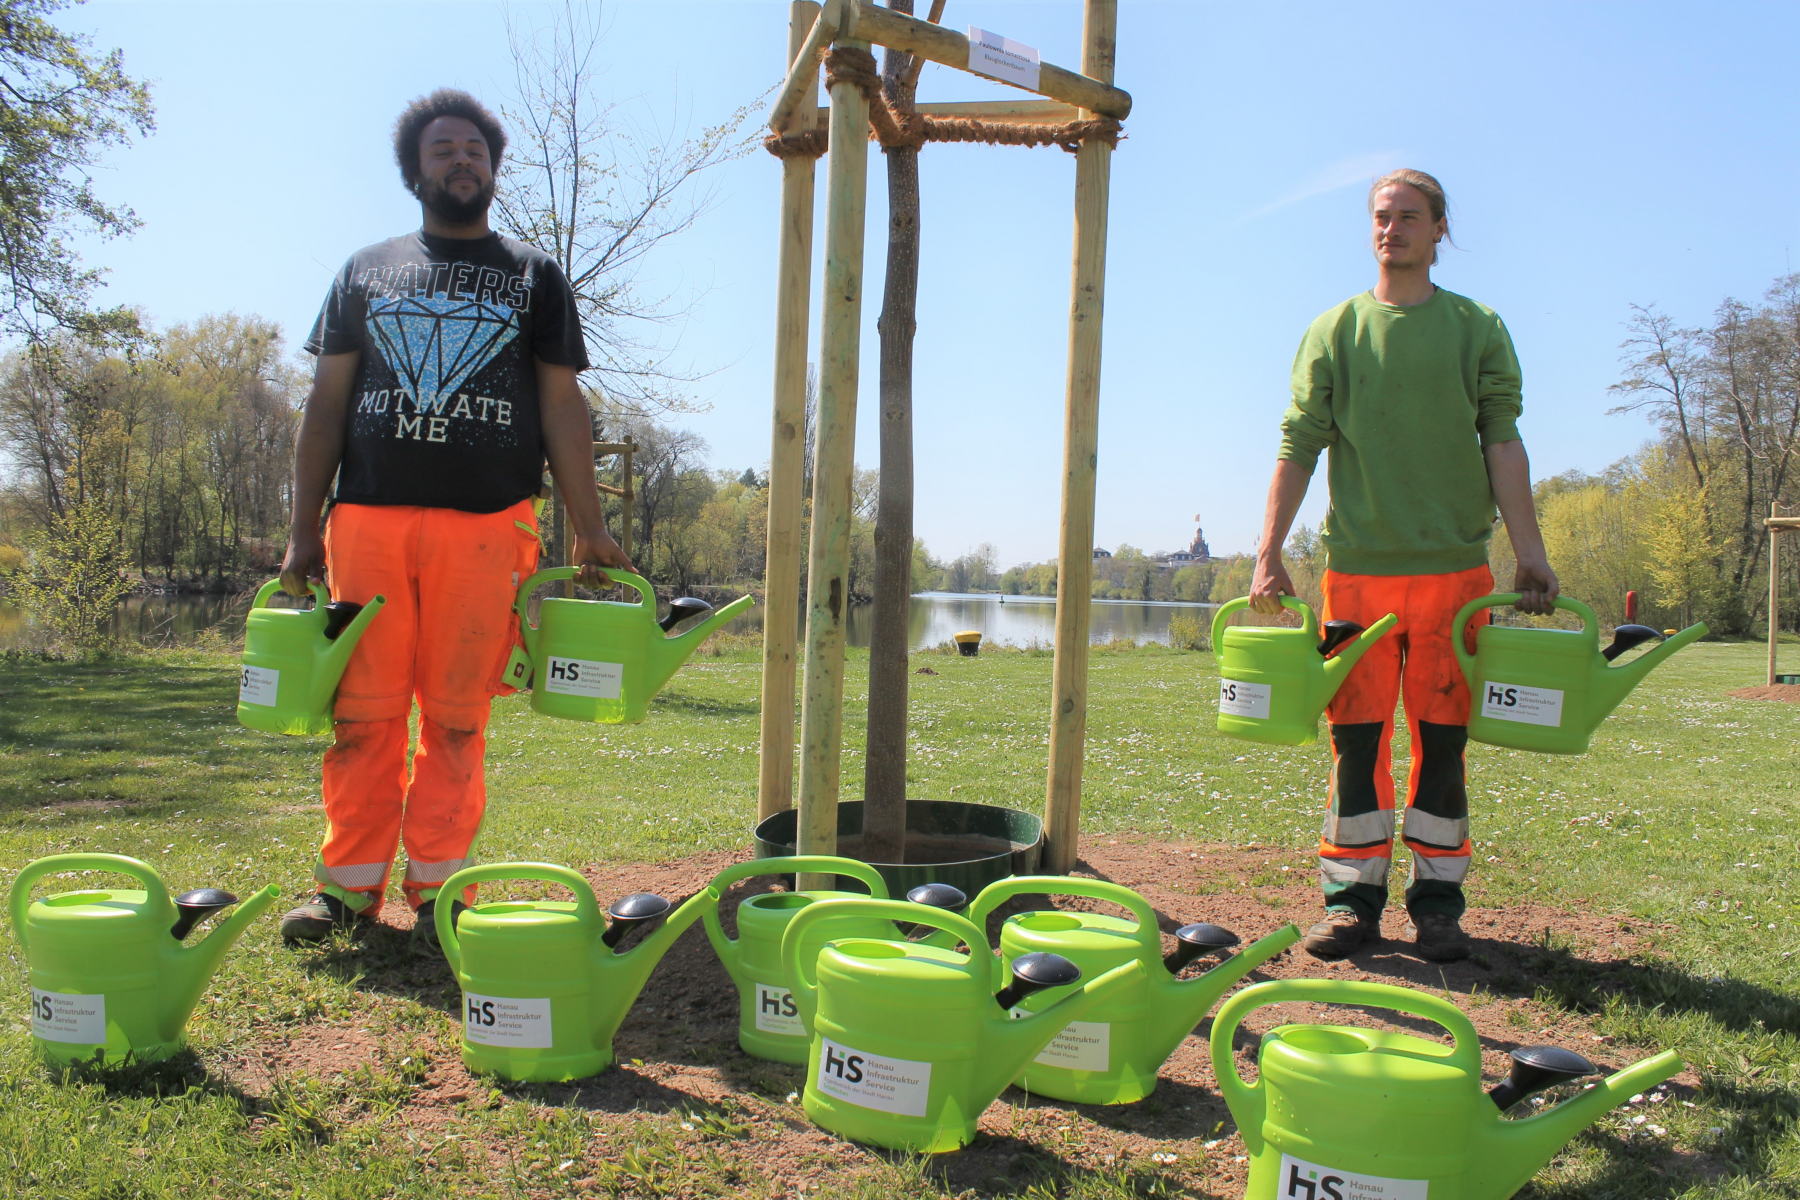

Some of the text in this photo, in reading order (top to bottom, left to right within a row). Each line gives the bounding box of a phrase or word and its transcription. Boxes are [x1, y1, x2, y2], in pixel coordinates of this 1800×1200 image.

[361, 262, 533, 312] HATERS
[357, 388, 512, 426] MOTIVATE
[395, 414, 449, 443] ME
[581, 670, 616, 678] Infrastruktur
[1519, 697, 1556, 706] Infrastruktur
[54, 998, 74, 1006] Hanau
[497, 1003, 519, 1011] Hanau
[54, 1007, 96, 1016] Infrastruktur
[497, 1012, 542, 1020] Infrastruktur
[55, 1015, 78, 1025] Service
[498, 1020, 523, 1029] Service
[1054, 1032, 1101, 1044] nfrastruktur
[1051, 1040, 1079, 1051] Service
[867, 1060, 894, 1071] Hanau
[866, 1069, 920, 1085] Infrastruktur
[865, 1079, 896, 1092] Service
[861, 1089, 876, 1097] Stadt
[876, 1092, 895, 1101] Hanau
[1349, 1180, 1384, 1193] Hanau
